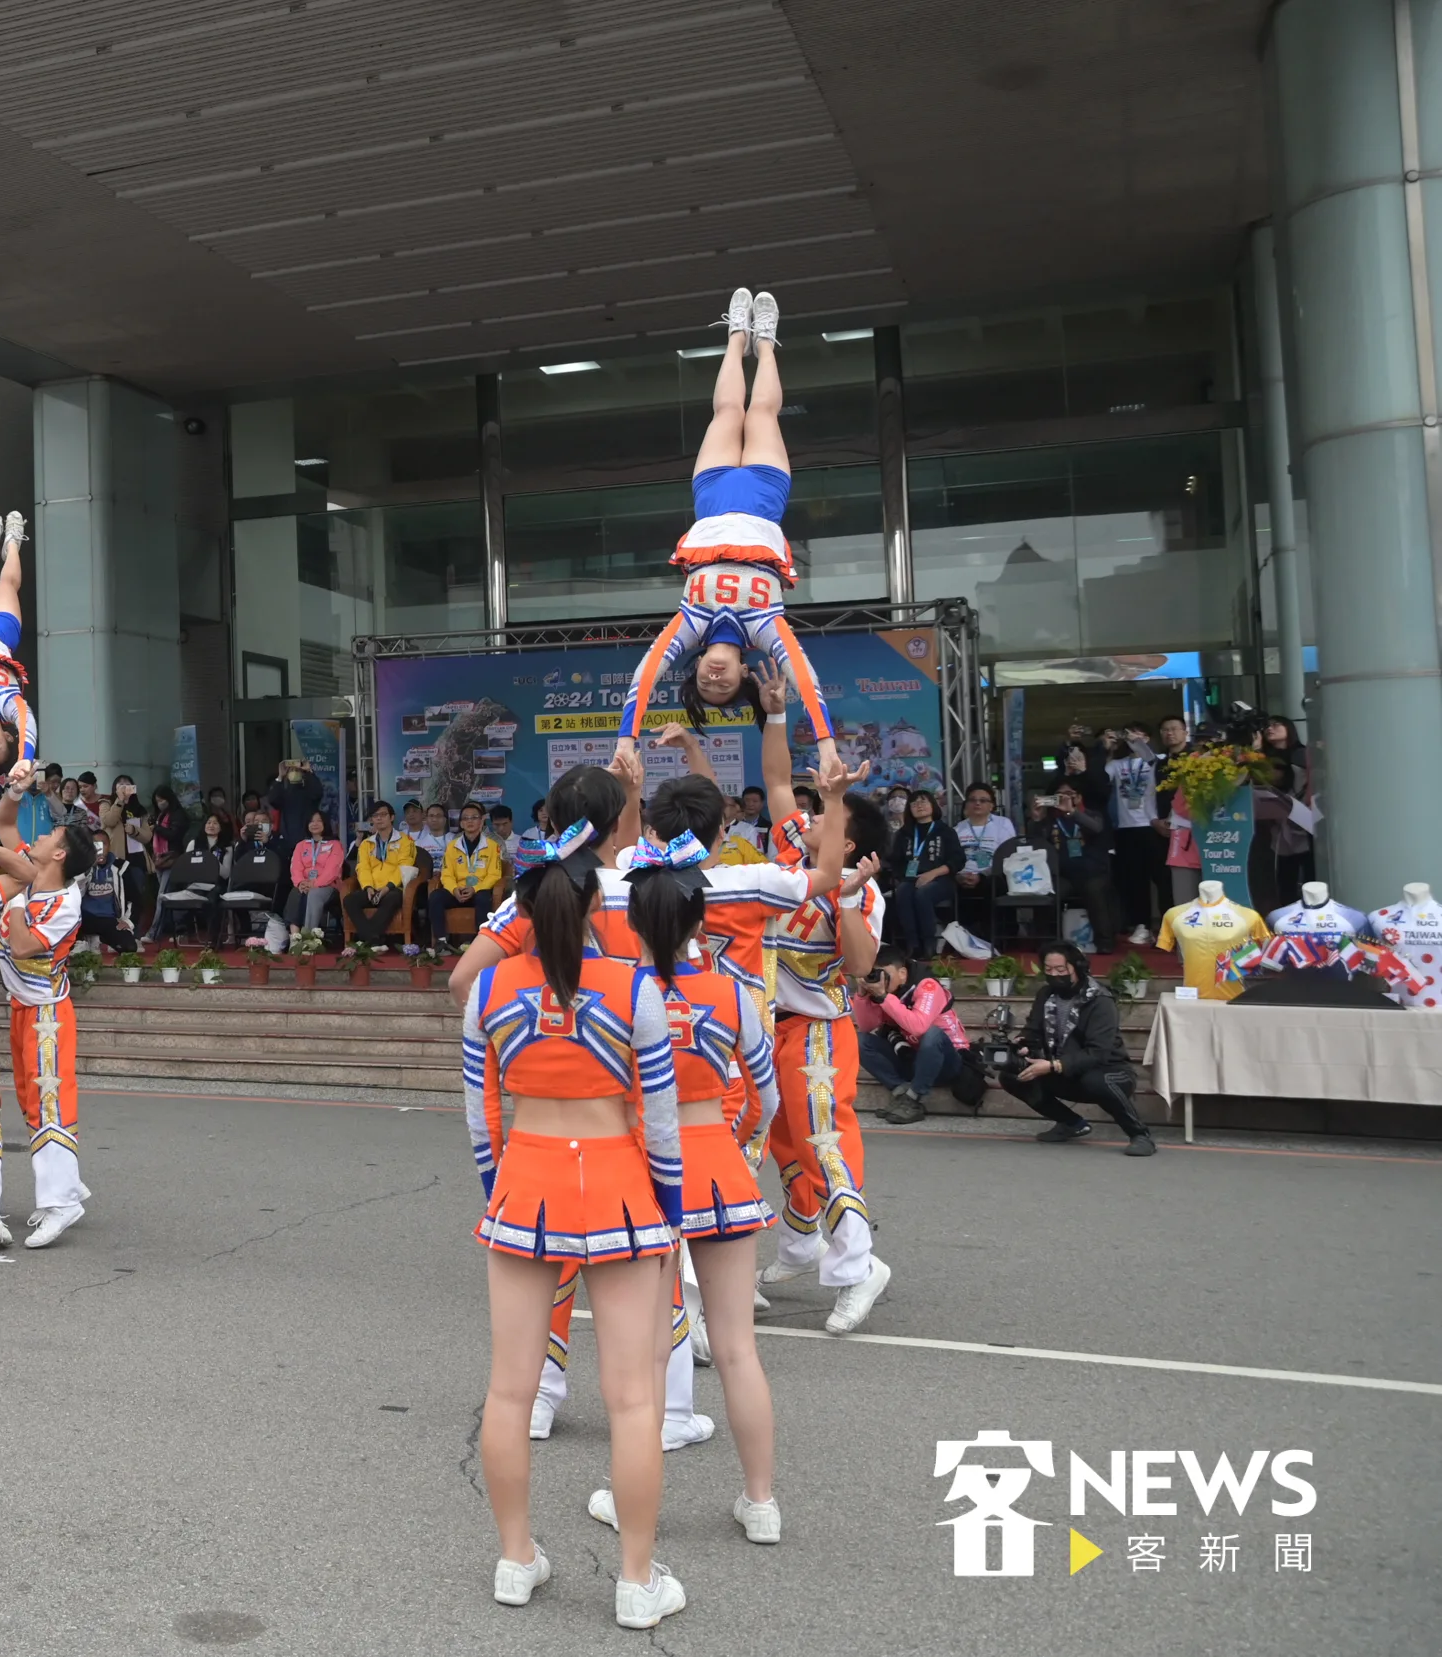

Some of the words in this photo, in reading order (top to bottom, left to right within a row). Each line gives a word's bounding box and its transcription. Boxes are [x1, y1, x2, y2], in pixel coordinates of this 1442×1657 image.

[856, 677, 921, 692] Taiwan
[1206, 831, 1240, 844] 2024
[1203, 848, 1222, 858] Tour
[1223, 849, 1236, 859] De
[1210, 863, 1241, 874] Taiwan
[88, 882, 113, 891] Roots
[776, 902, 824, 943] H
[539, 983, 576, 1037] S
